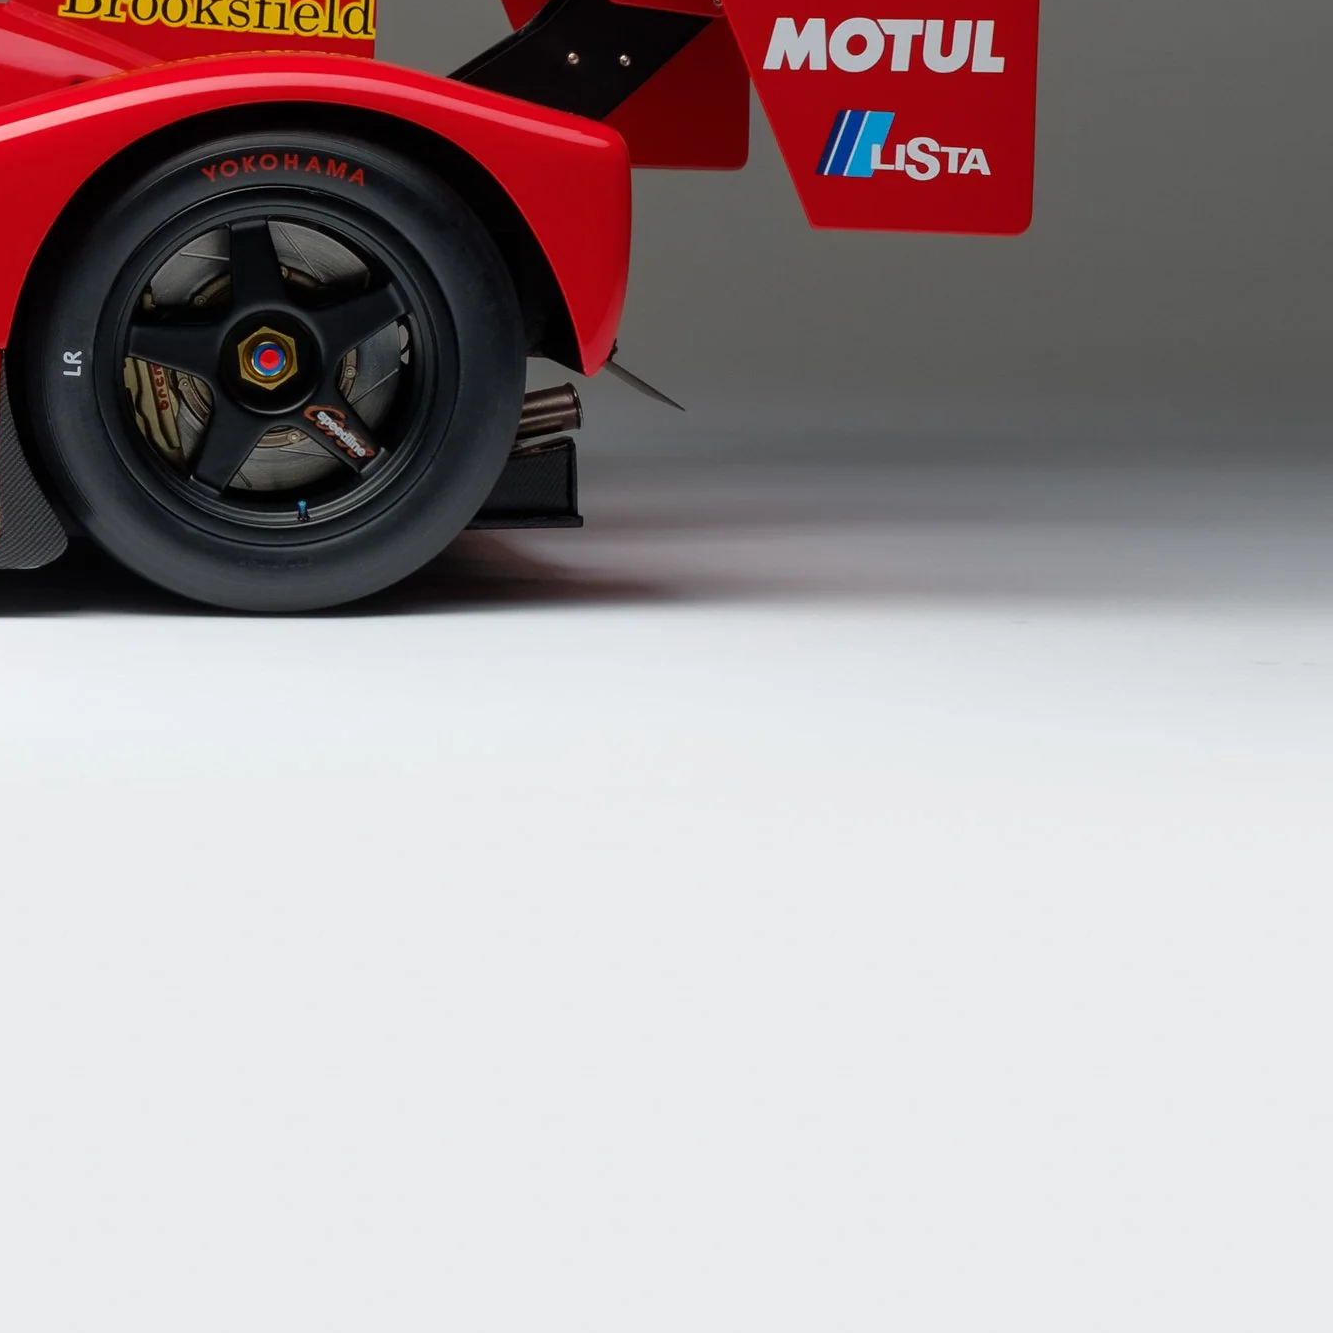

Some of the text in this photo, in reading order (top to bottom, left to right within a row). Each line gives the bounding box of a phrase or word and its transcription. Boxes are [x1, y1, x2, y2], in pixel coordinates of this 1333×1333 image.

[763, 17, 1005, 73] MOTUL
[201, 152, 365, 186] YOKOHAMA
[871, 136, 991, 181] LISTA
[63, 350, 83, 377] LR
[154, 362, 170, 411] brem
[317, 411, 366, 457] speedline
